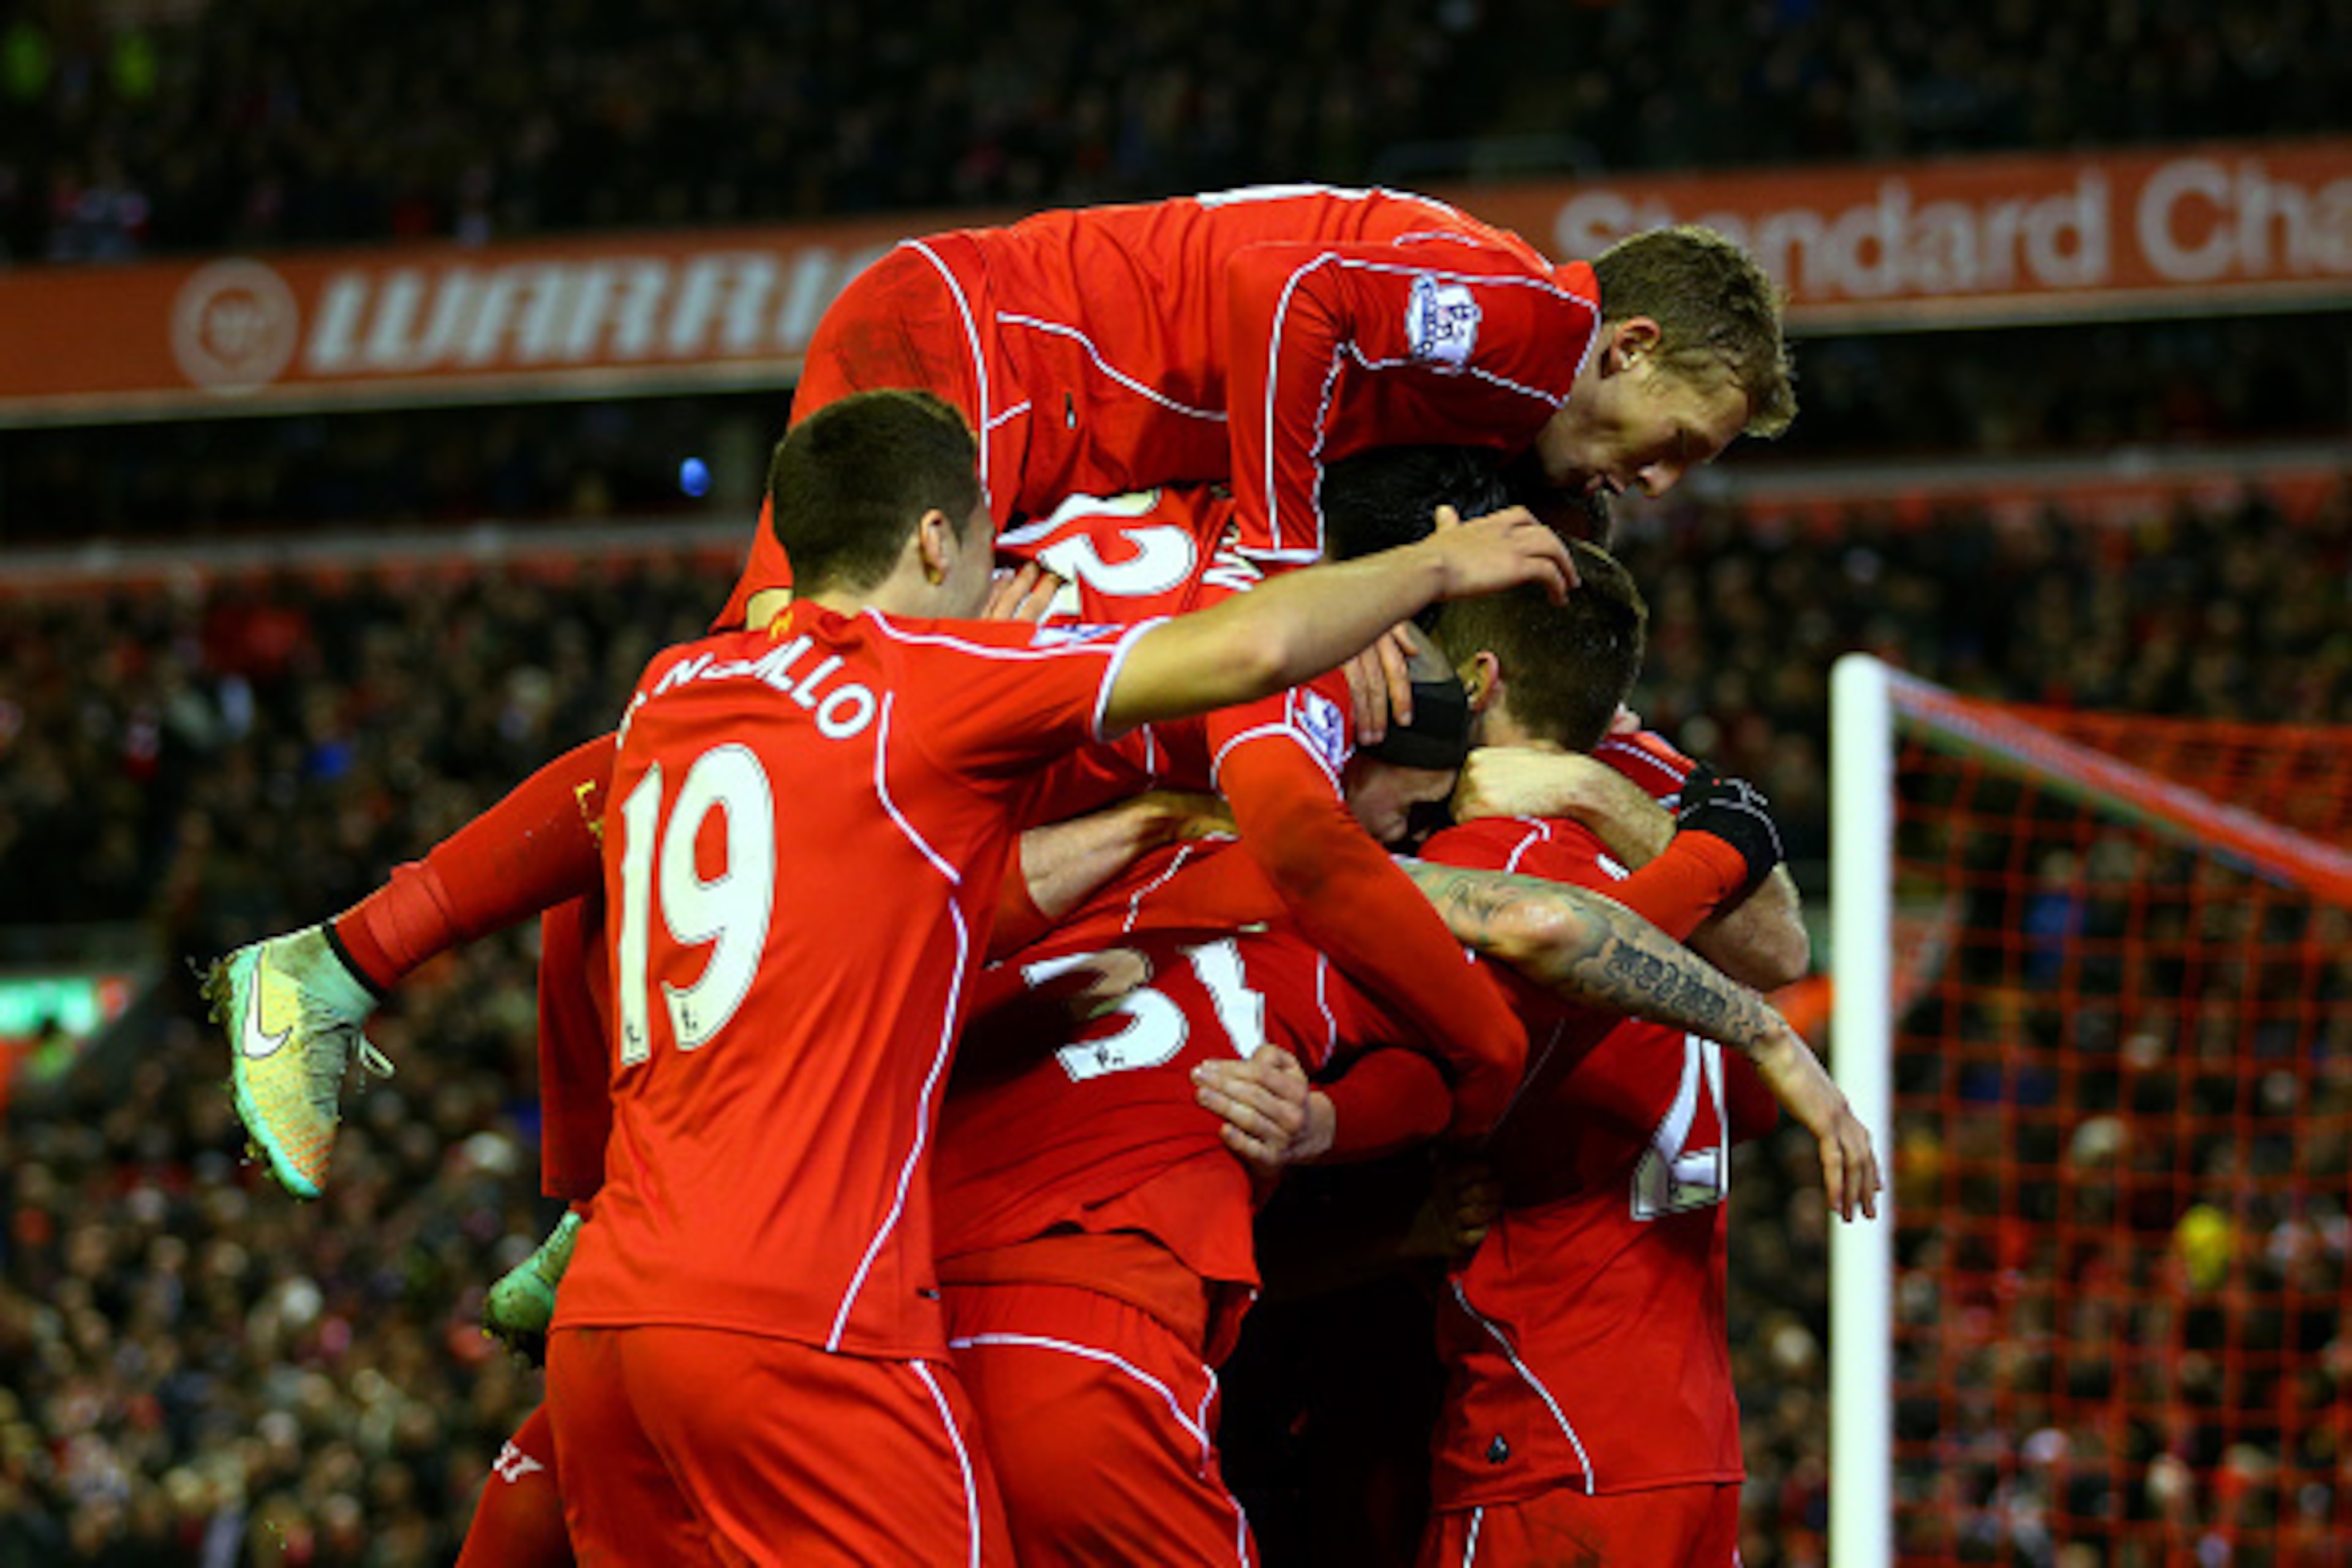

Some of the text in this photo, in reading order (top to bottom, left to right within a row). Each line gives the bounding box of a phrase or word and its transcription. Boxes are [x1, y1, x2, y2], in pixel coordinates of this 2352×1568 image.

[308, 247, 885, 376] WARRI
[619, 742, 776, 1067] 19
[1021, 937, 1265, 1082] 31
